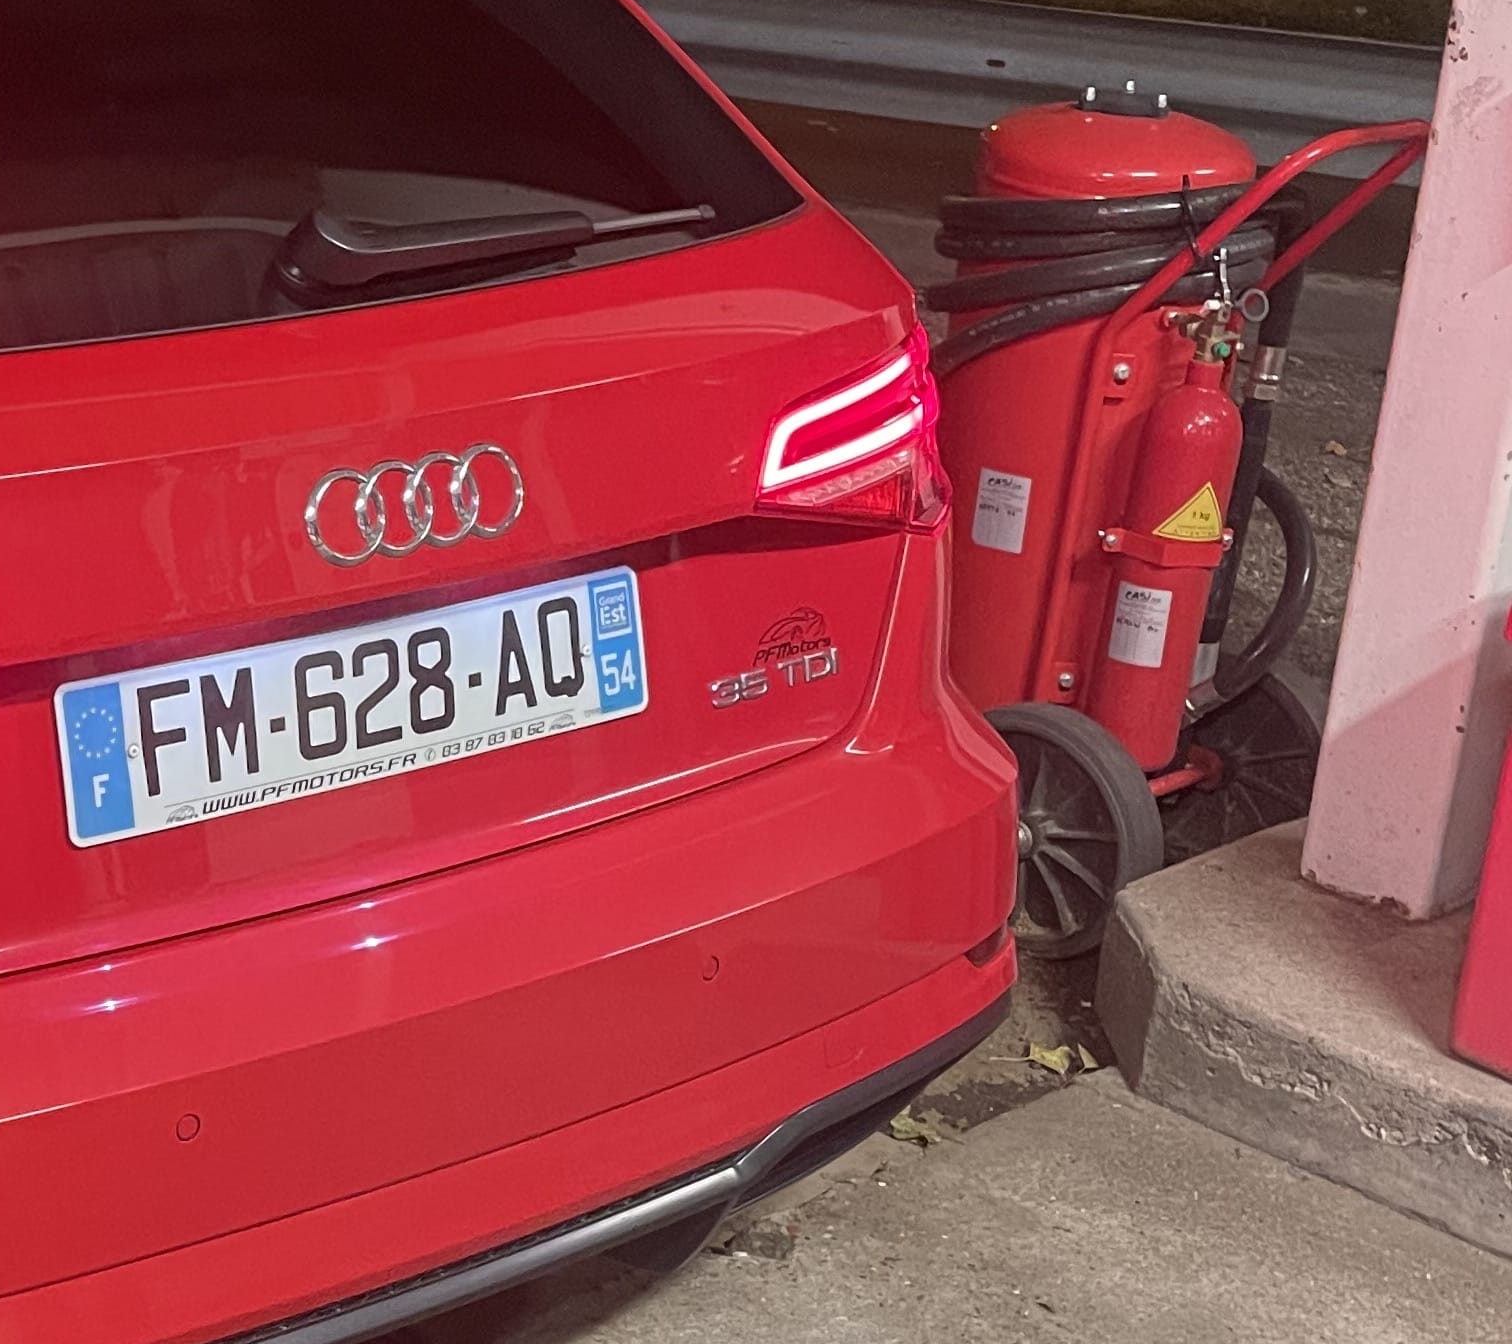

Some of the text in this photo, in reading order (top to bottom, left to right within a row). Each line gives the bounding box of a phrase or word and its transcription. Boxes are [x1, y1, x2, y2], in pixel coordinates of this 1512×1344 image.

[599, 602, 627, 627] Est
[600, 649, 636, 697] 54
[710, 646, 840, 710] 35 TDI
[136, 597, 585, 797] FM-628-AQ
[465, 737, 484, 753] 87
[93, 773, 109, 808] F
